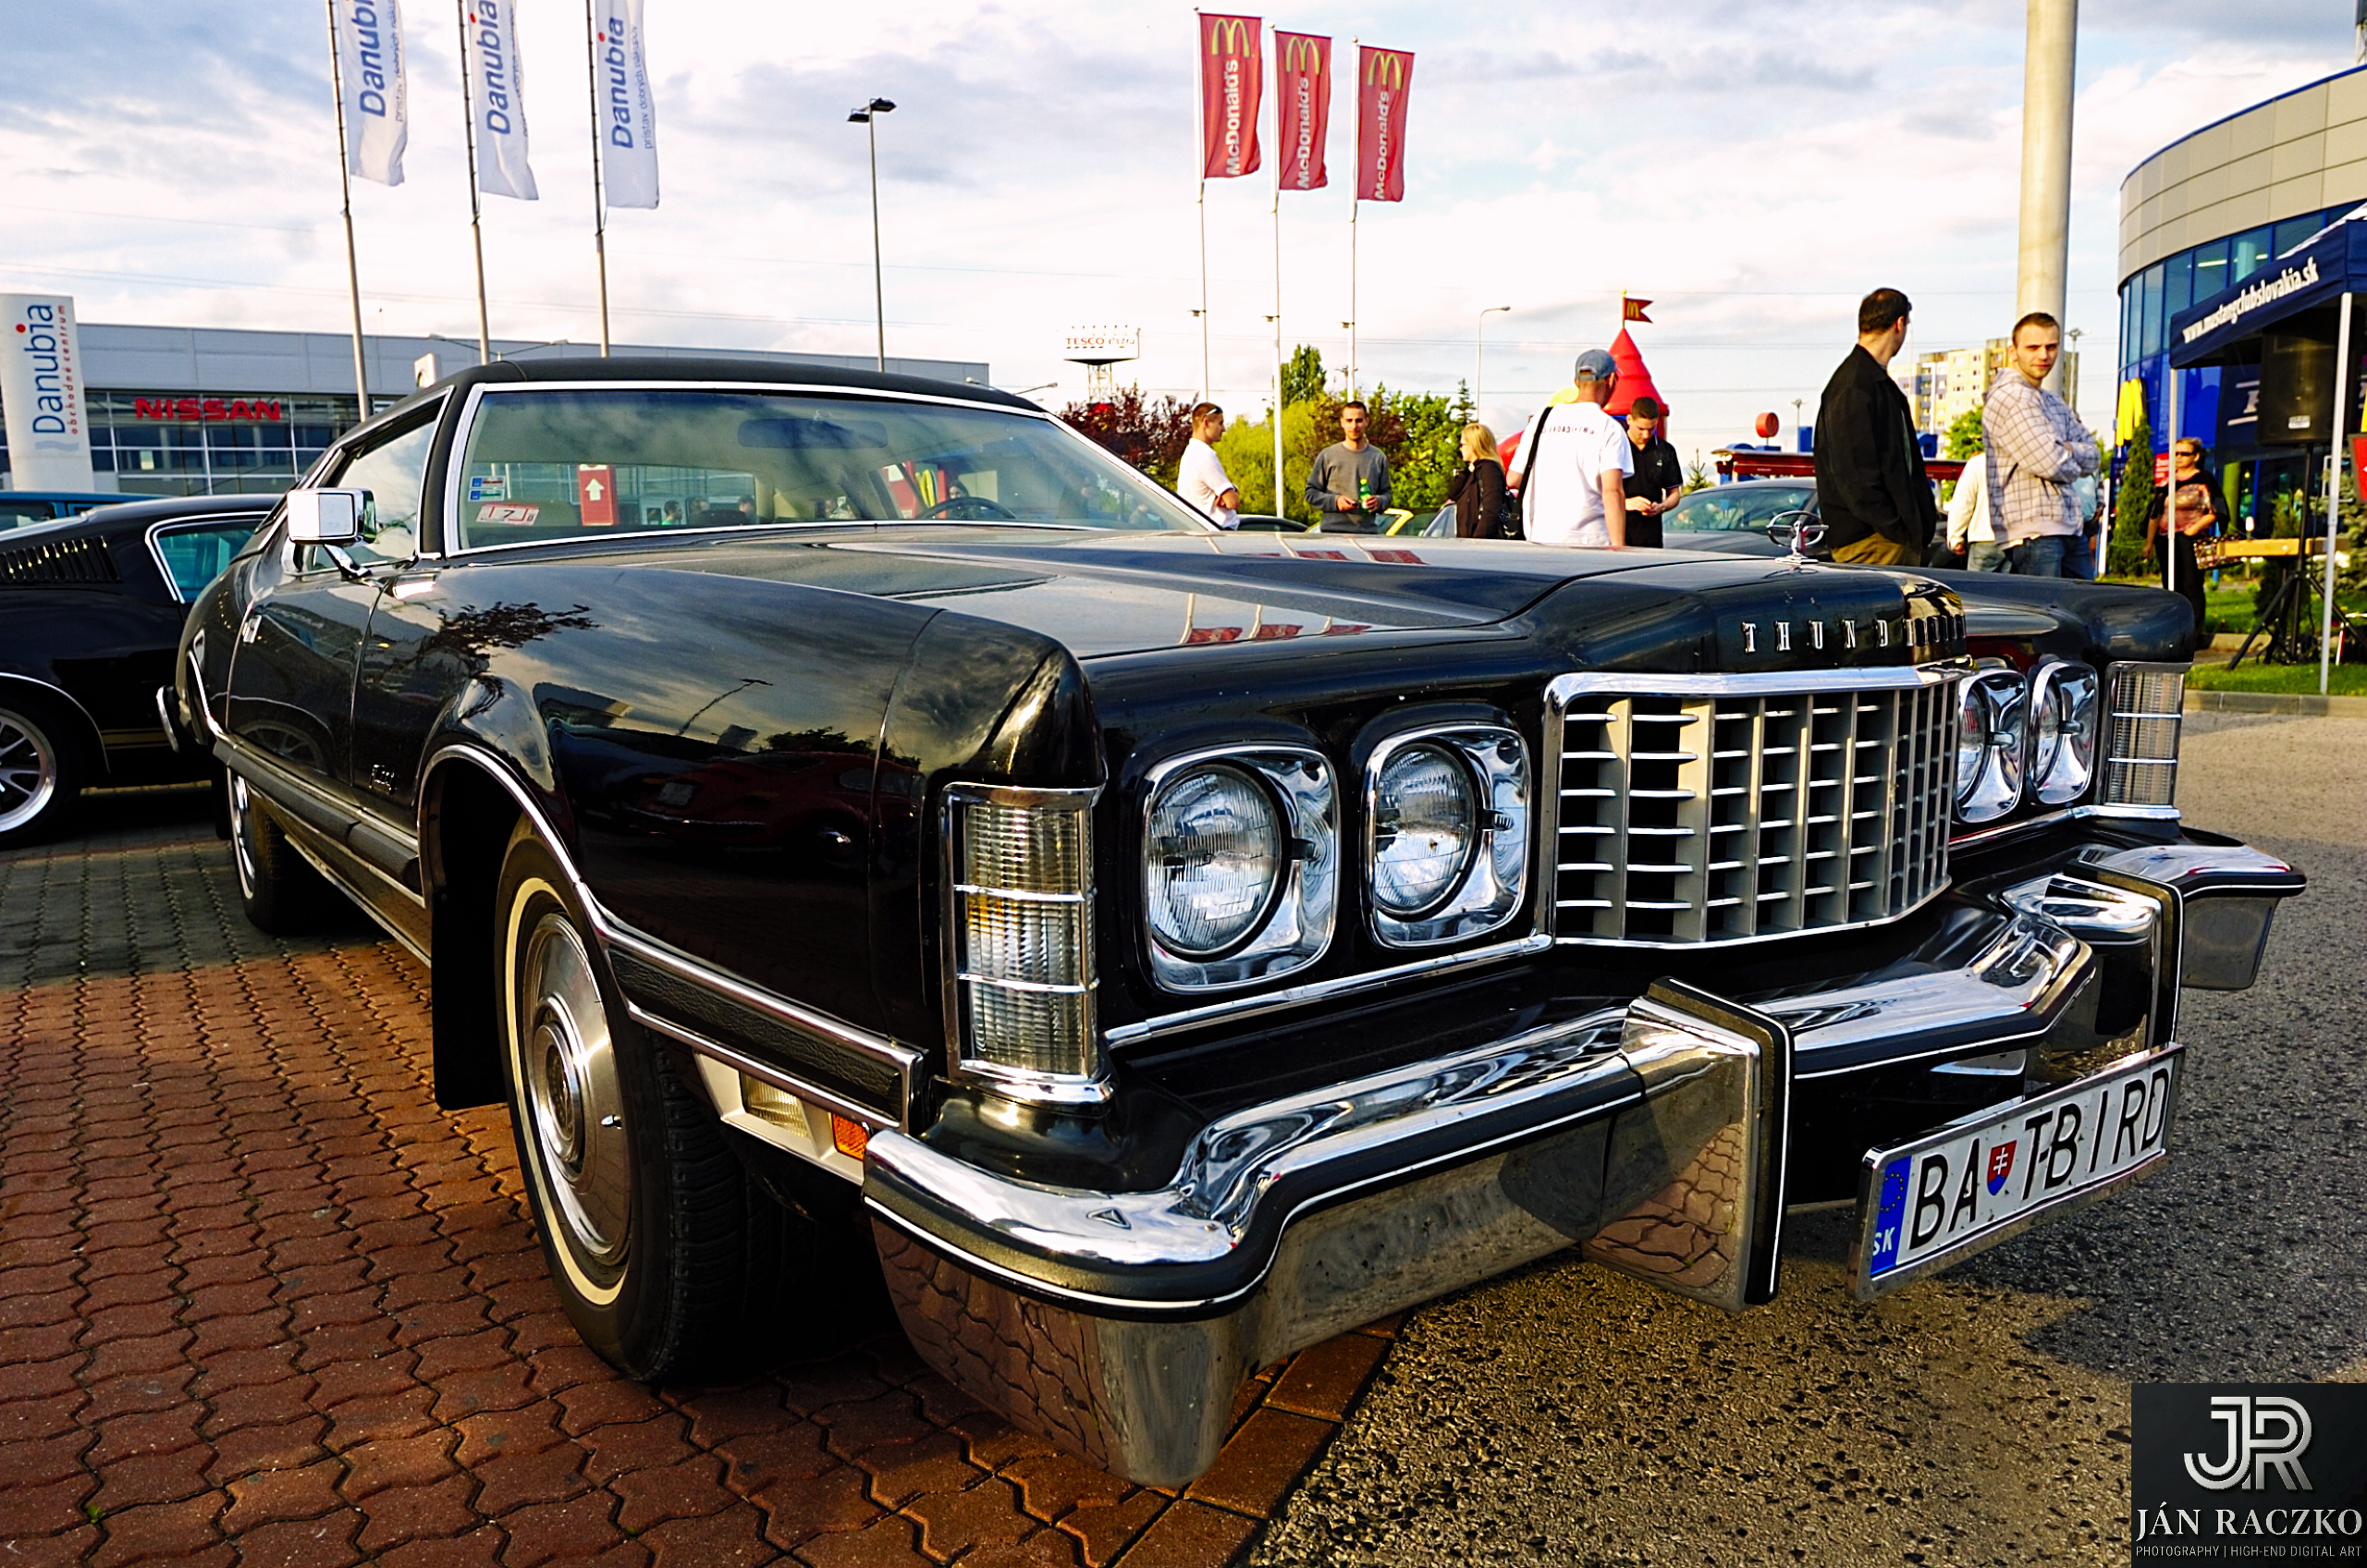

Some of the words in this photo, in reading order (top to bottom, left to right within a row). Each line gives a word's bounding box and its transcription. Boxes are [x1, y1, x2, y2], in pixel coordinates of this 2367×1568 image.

[470, 0, 510, 135] Danubia
[598, 17, 633, 149] Danubia
[1224, 59, 1241, 175] McDonald's
[1297, 77, 1311, 189] McDonald's
[1375, 91, 1390, 200] McDonald's
[16, 304, 66, 434] Danubia
[57, 305, 70, 361] centrum
[1065, 337, 1105, 346] TESCO
[135, 398, 281, 421] NISSAN
[1872, 1227, 1895, 1256] SK
[1909, 1138, 1981, 1250] BA
